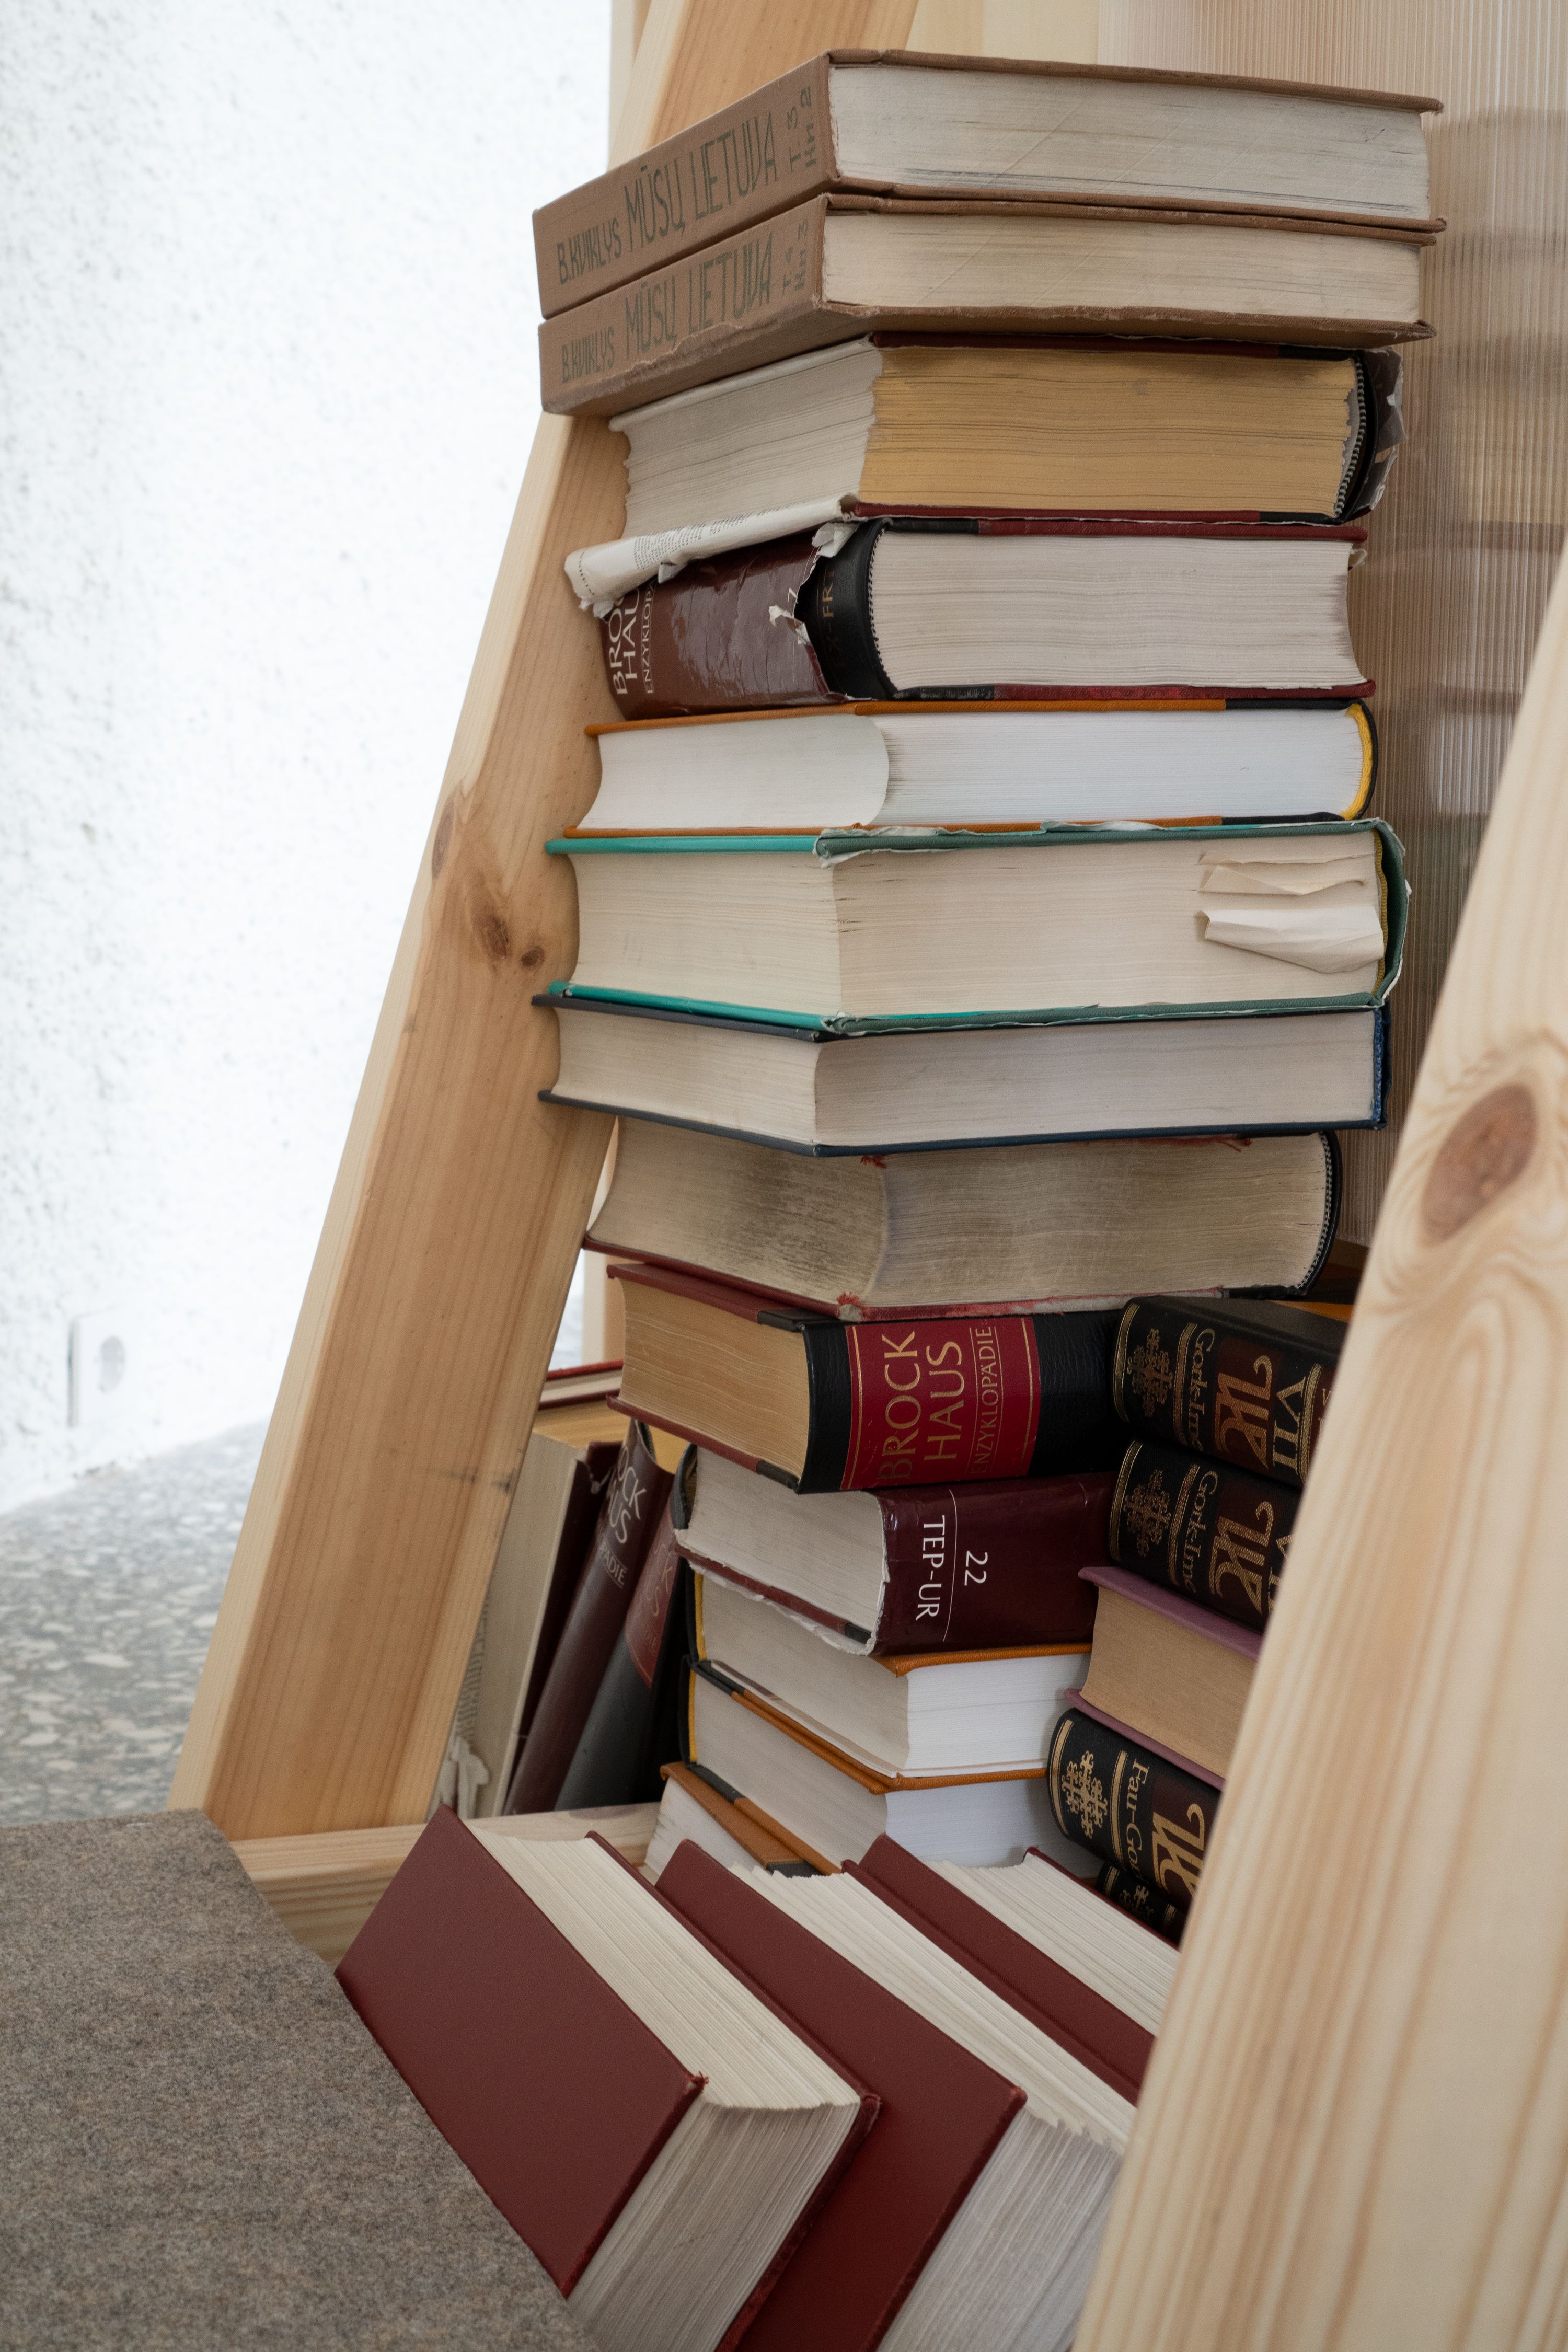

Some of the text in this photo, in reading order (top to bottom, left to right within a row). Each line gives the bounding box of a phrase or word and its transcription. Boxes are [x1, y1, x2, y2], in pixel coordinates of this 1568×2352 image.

[689, 111, 777, 220] LIETUVA
[688, 230, 773, 335] LIETUVA
[608, 596, 628, 695] BRO
[622, 588, 640, 679] HAU
[877, 1330, 921, 1480] BROCK
[924, 1341, 965, 1461] HAUS
[971, 1325, 999, 1474] ENZYKLOPÄDIE
[1272, 1376, 1306, 1475] VII
[916, 1515, 946, 1621] TEP-UR
[964, 1550, 988, 1586] 22
